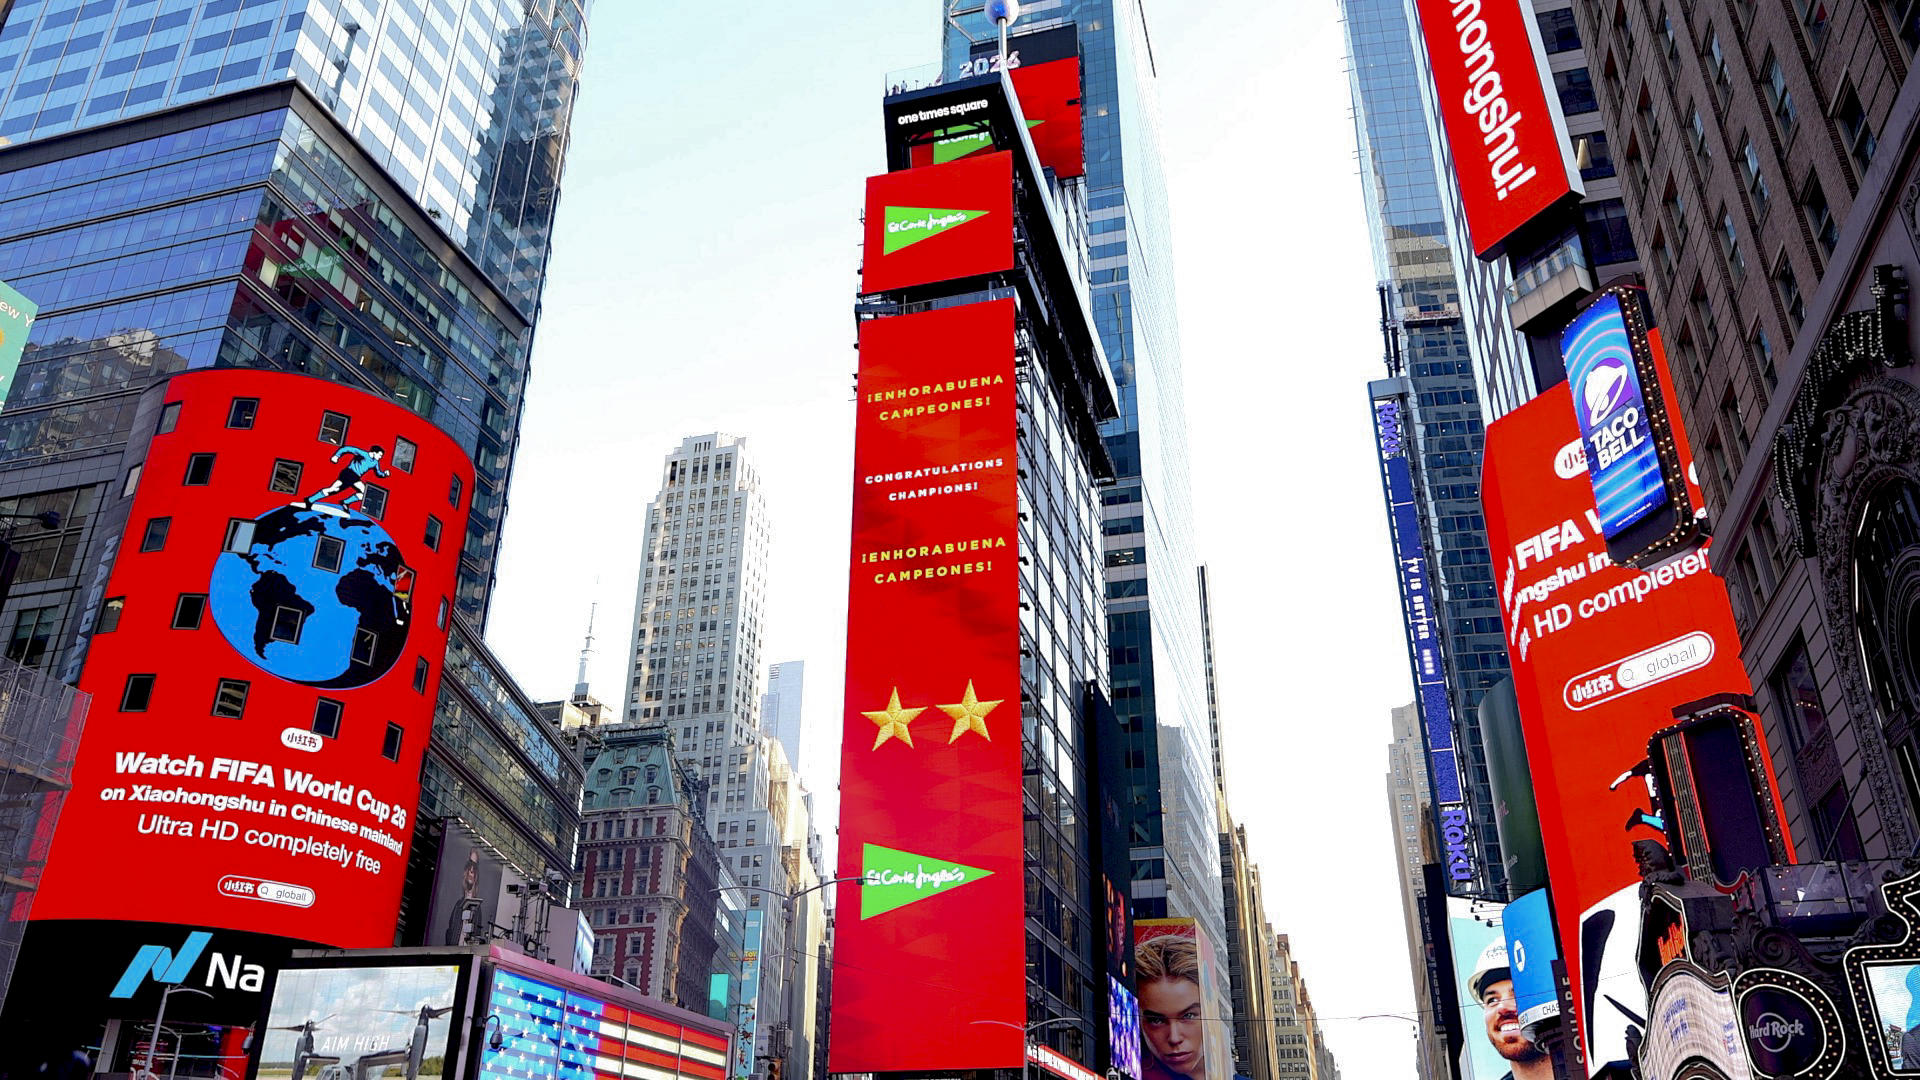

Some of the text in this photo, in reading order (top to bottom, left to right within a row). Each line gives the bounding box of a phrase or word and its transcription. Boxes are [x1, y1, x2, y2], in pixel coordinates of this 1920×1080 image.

[959, 50, 1021, 79] 2026
[898, 99, 988, 125] one times square
[867, 374, 1004, 404] ¡ENHORABUENA
[879, 396, 991, 421] CAMPEONES!
[1590, 407, 1639, 452] TACO
[1597, 428, 1645, 471] BELL
[865, 458, 1004, 485] CONGRATULATIONS
[888, 481, 979, 502] CHAMPIONS!
[861, 536, 1007, 564] ¡ENHORABUENA
[1515, 519, 1585, 571] FIFA
[874, 560, 993, 584] CAMPEONES!
[1407, 557, 1420, 574] TV
[1409, 577, 1422, 590] IS
[1533, 603, 1573, 638] HD
[1578, 548, 1709, 619] completel
[1412, 595, 1430, 641] BETTER
[1646, 643, 1697, 677] globall
[115, 752, 408, 830] Watch FIFA World Cup 26
[100, 784, 404, 857] on Xiaohongshu in Chinese mainland
[137, 813, 381, 875] Ultra HD completely free
[1542, 1002, 1561, 1016] CHAS
[321, 1034, 391, 1052] AIM HIGH
[1749, 1022, 1770, 1039] Hard
[1771, 1019, 1805, 1038] Rock
